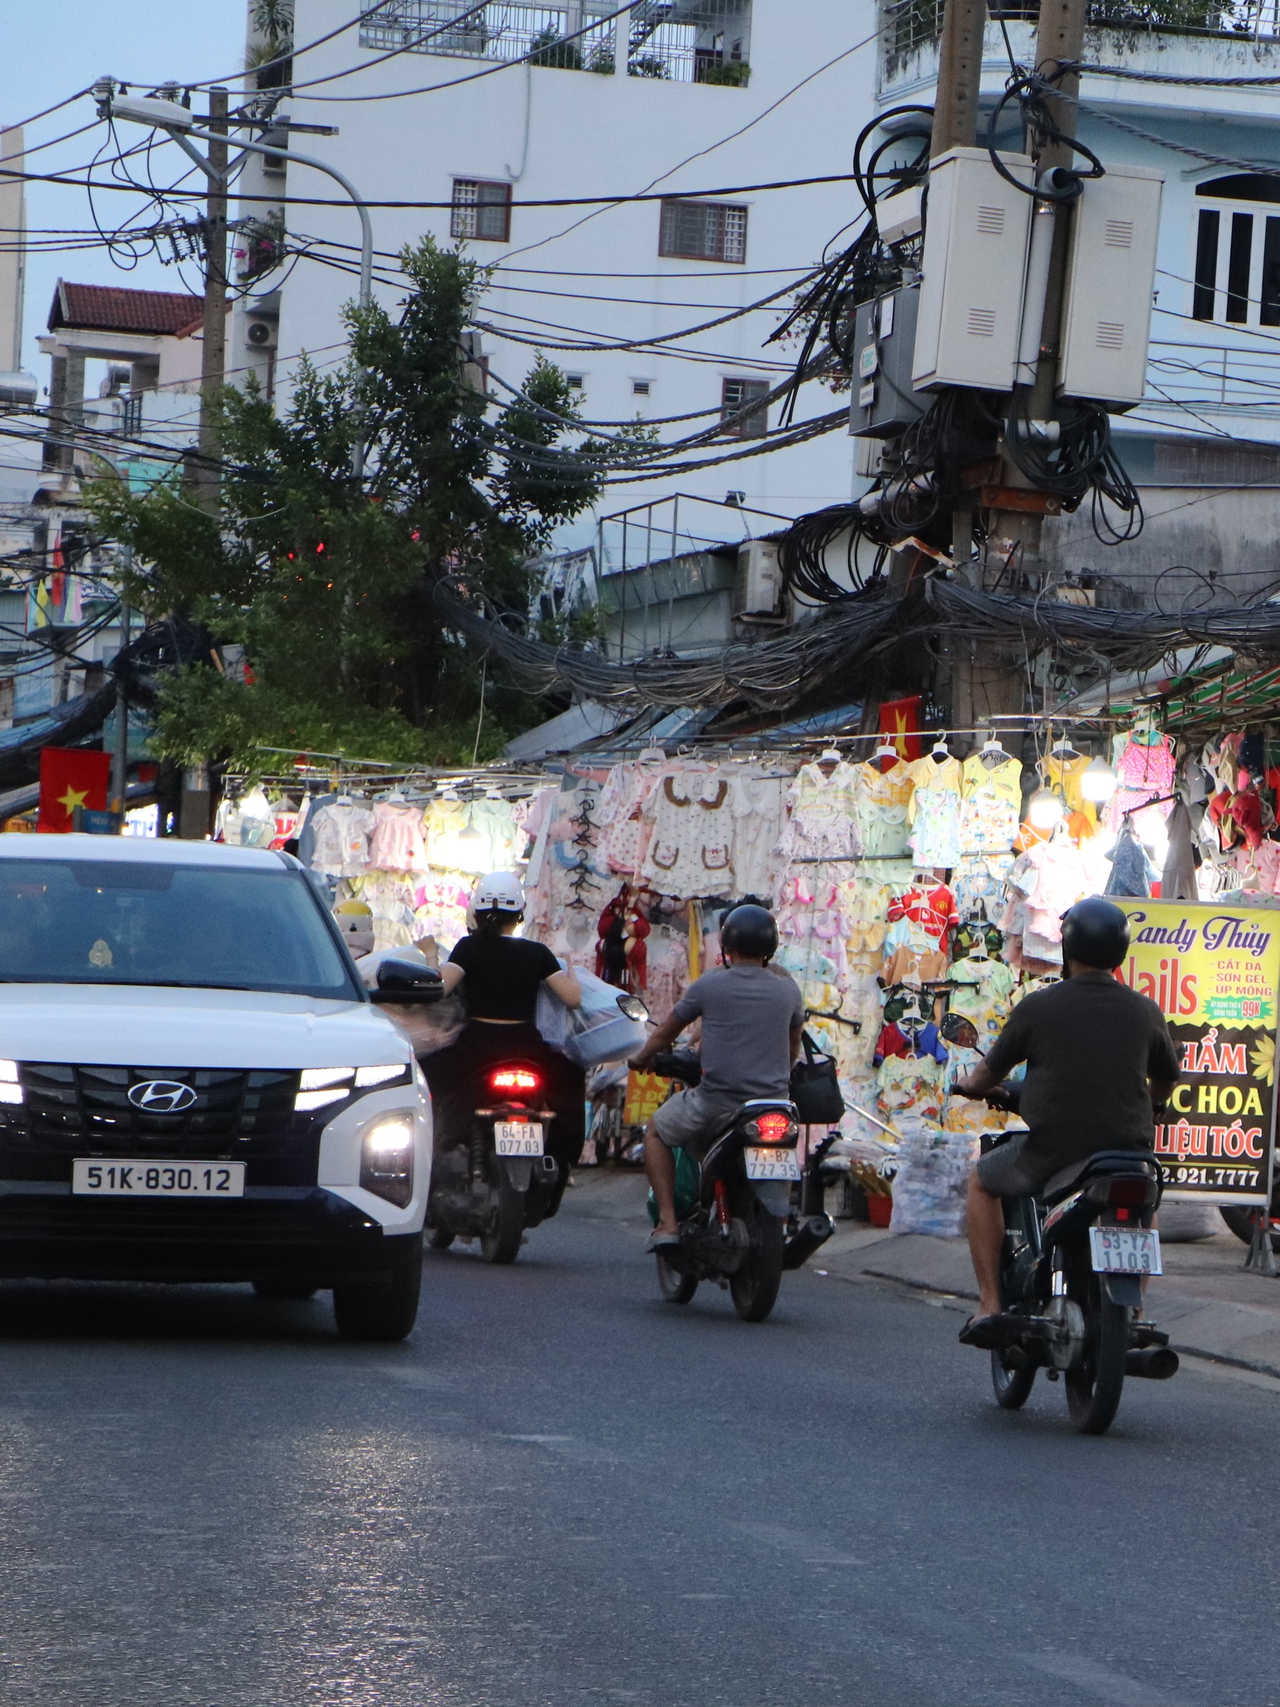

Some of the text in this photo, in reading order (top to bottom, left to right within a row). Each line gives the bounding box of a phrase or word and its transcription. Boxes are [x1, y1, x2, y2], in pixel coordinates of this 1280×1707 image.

[1127, 911, 1271, 957] Candy Thủy
[1245, 962, 1262, 971] DA
[1112, 956, 1198, 1016] Nails
[1216, 973, 1241, 983] SƠN
[1245, 974, 1267, 984] GEL
[1236, 985, 1272, 996] MÓNG
[1242, 1001, 1260, 1017] 99K
[1179, 1027, 1248, 1075] HẨM
[1197, 1086, 1264, 1116] HOA
[502, 1125, 536, 1140] 64-FA
[1154, 1117, 1264, 1162] LIỆU TÓC
[500, 1140, 540, 1154] 077.03
[753, 1149, 790, 1163] 71-B2
[88, 1166, 231, 1191] 51K-830.12
[750, 1163, 797, 1178] 727.35
[1161, 1167, 1260, 1187] 2.921.7777
[1102, 1232, 1150, 1251] 53-Y7
[1103, 1251, 1151, 1269] 1103
